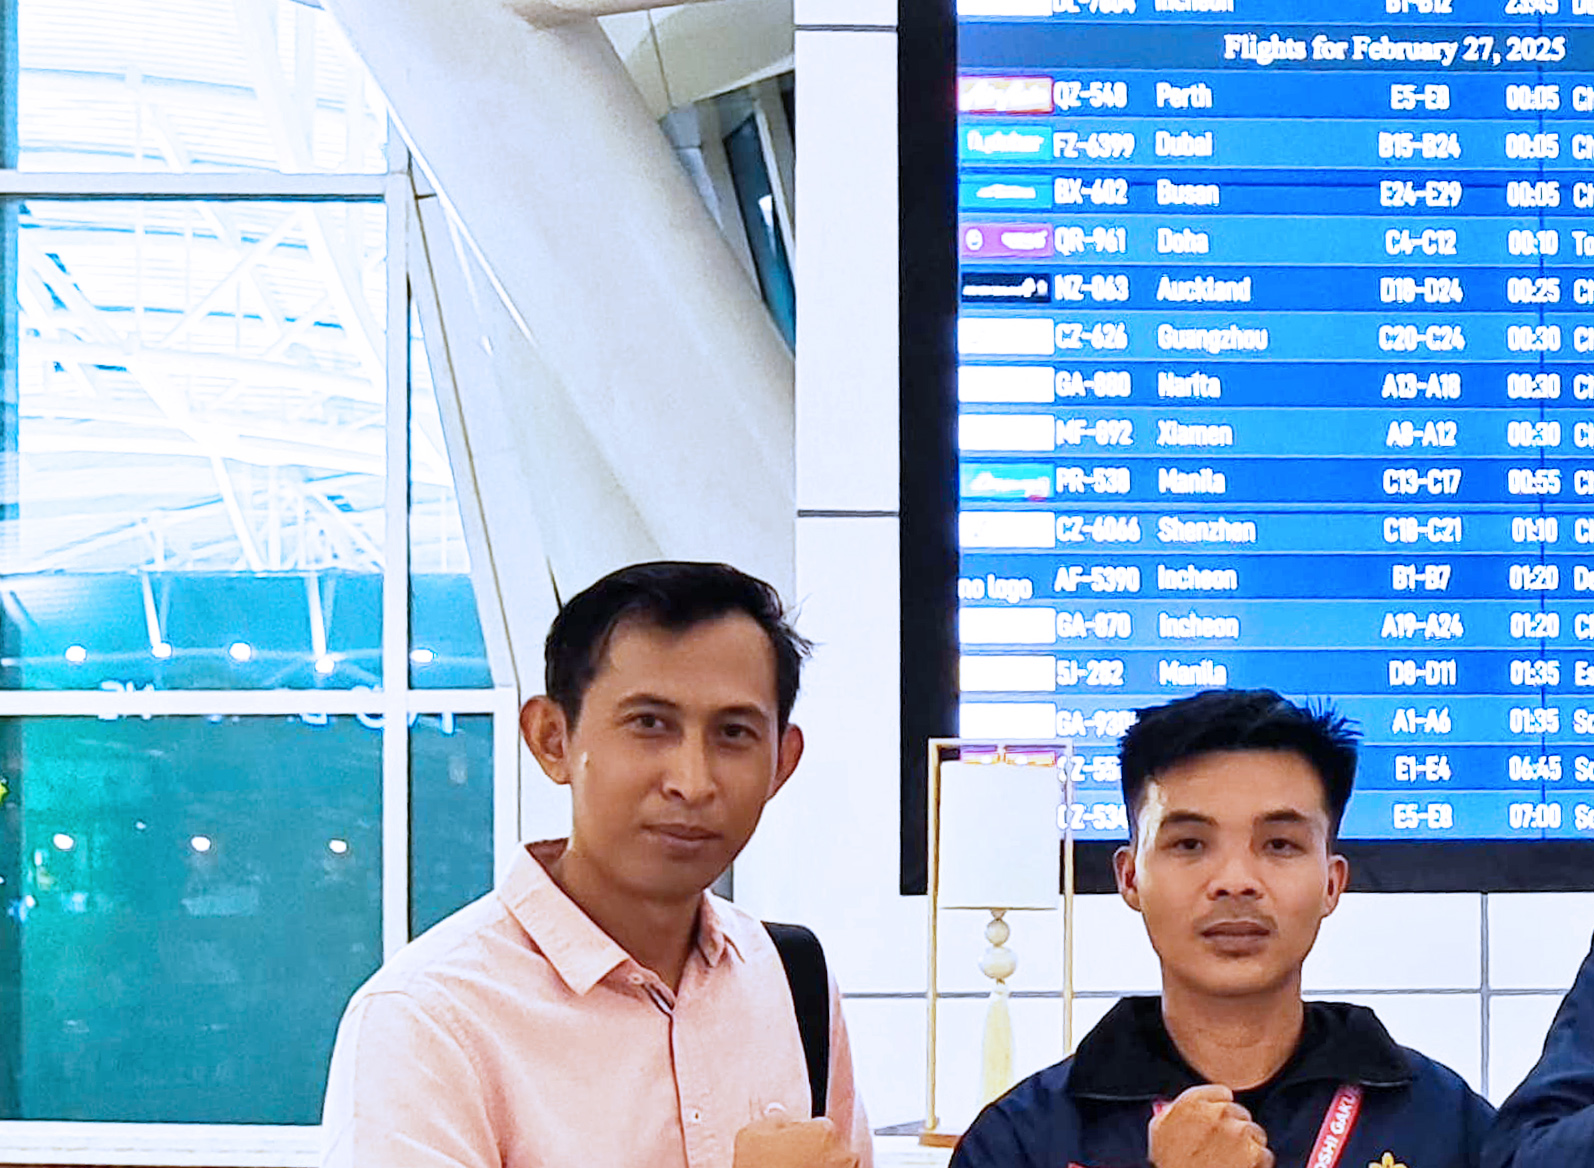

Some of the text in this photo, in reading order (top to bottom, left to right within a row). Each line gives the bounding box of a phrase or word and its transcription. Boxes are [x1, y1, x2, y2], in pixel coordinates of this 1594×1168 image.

[1223, 34, 1566, 66] Flights for February 27, 2025
[1156, 82, 1212, 108] Perth
[1506, 85, 1560, 110] 00:05
[1155, 131, 1213, 157] Dubai
[1505, 133, 1559, 159] 00:05
[1157, 179, 1220, 205] Busan
[1506, 181, 1560, 207] 00:05
[1157, 227, 1209, 254] Doha
[1385, 229, 1457, 255] C4-C12
[1508, 229, 1559, 255] 00:10
[1156, 276, 1251, 302] Auckland
[1507, 277, 1560, 303] 00:25
[1157, 324, 1268, 354] Guangzhou
[1507, 325, 1561, 351] 00:30
[1158, 372, 1221, 398] Narita
[1507, 373, 1561, 399] 00:30
[1156, 420, 1233, 447] Xiamen
[1507, 421, 1561, 447] 00:30
[1158, 468, 1226, 494] Manila
[1508, 469, 1561, 494] 00:55
[1157, 516, 1256, 543] Shenzhen
[987, 573, 1034, 604] logo
[1157, 564, 1238, 590] Incheon
[1509, 565, 1559, 590] 01:20
[1159, 612, 1239, 638] Incheon
[1510, 612, 1560, 638] 01:20
[1159, 660, 1227, 686] Manila
[1510, 660, 1560, 686] 01:35
[1509, 708, 1560, 733] 01:35
[1508, 755, 1562, 781] 06:45
[1509, 803, 1562, 829] 07:00
